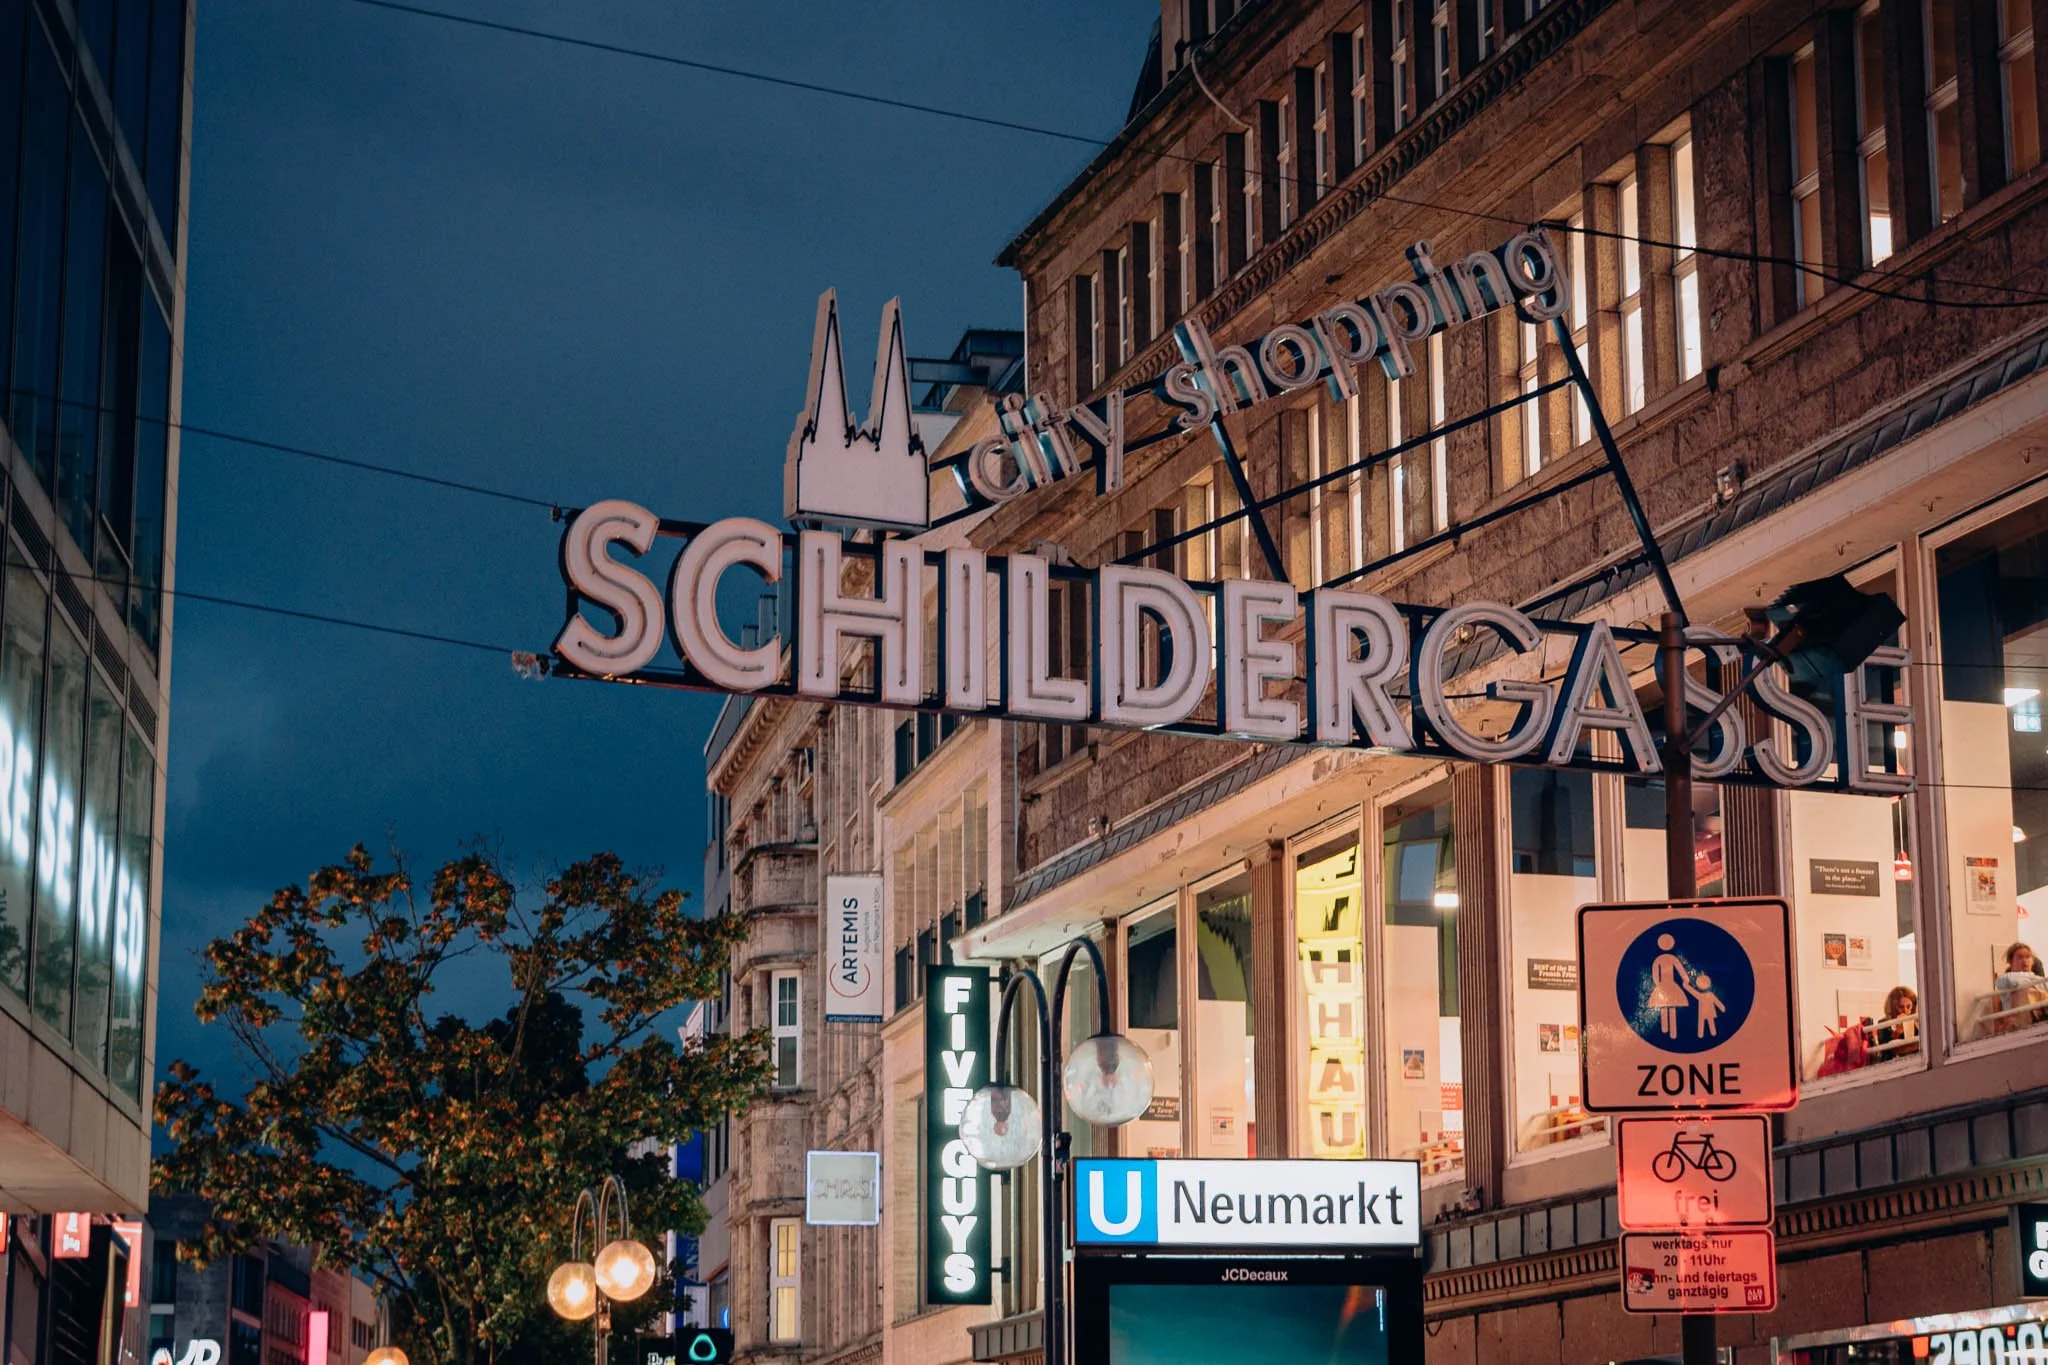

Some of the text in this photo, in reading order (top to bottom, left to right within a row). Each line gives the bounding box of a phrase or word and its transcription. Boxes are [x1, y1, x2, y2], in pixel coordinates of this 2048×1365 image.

[958, 228, 1571, 502] city shopping
[553, 499, 1918, 796] SCHILDERGASSE
[842, 897, 859, 985] ARTEMIS
[1637, 1062, 1741, 1097] ZONE
[941, 976, 978, 1293] FIVE GUYS
[1089, 1170, 1404, 1236] U Neumarkt
[1675, 1189, 1719, 1213] frei
[1652, 1238, 1733, 1252] werktags nur
[1221, 1268, 1288, 1282] JCDecaux
[1663, 1255, 1678, 1267] 20
[1667, 1285, 1729, 1300] ganztägig
[1676, 1271, 1700, 1283] und
[1703, 1271, 1758, 1286] feiertags
